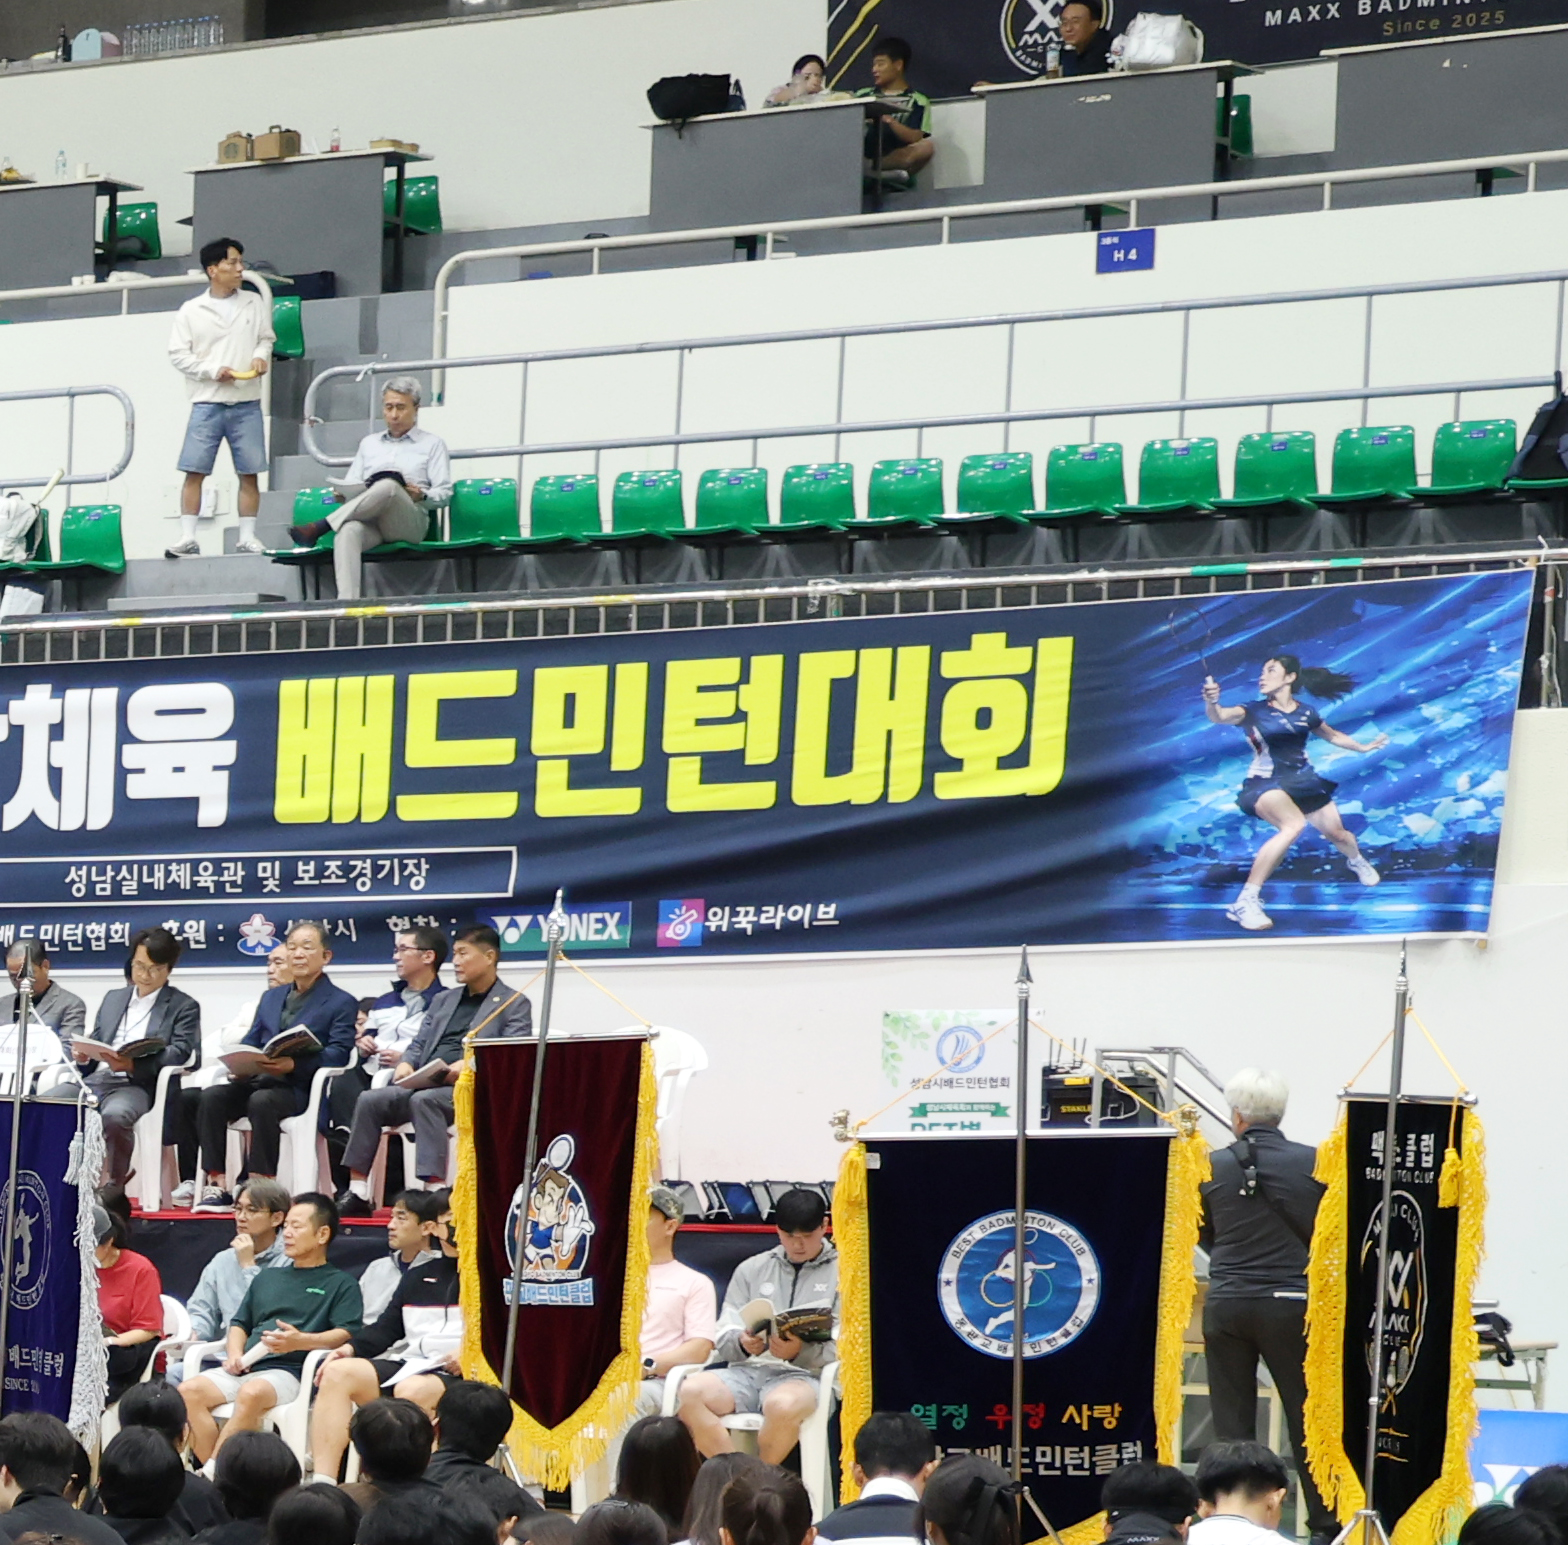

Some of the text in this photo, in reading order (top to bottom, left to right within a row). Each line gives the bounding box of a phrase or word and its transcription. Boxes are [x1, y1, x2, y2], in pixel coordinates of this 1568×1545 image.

[1265, 2, 1341, 27] MAXX
[1383, 10, 1505, 36] Since 2025
[1127, 248, 1137, 260] 4
[275, 632, 1074, 824] 배드민턴대회
[64, 858, 431, 901] 성남실내체육관 및 보조경기장
[705, 903, 840, 935] 위꾹라이브
[909, 1076, 1011, 1090] 성남시배드민턴협회
[952, 1231, 980, 1260] BEST
[1059, 1228, 1086, 1257] CLUB
[911, 1402, 1123, 1431] 열정 우정 사랑
